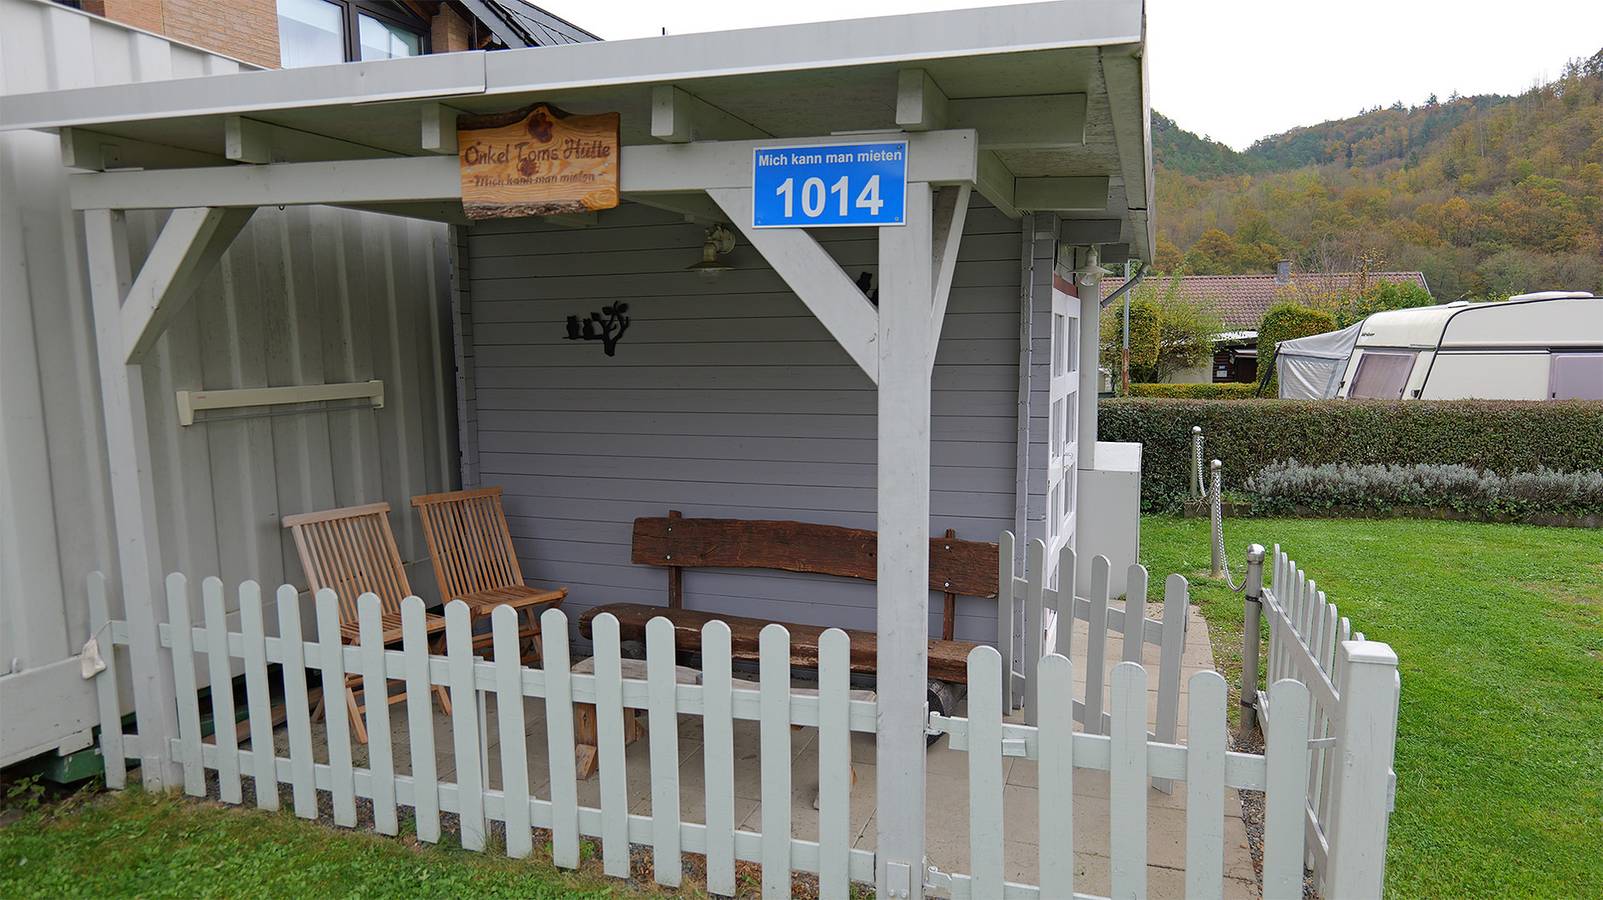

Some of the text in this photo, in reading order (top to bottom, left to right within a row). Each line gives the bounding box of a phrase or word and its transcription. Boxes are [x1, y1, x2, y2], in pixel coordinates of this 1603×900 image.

[464, 138, 611, 165] Onkel Toms Hütte
[758, 150, 902, 166] Mich kann man mieten
[776, 175, 884, 217] 1014
